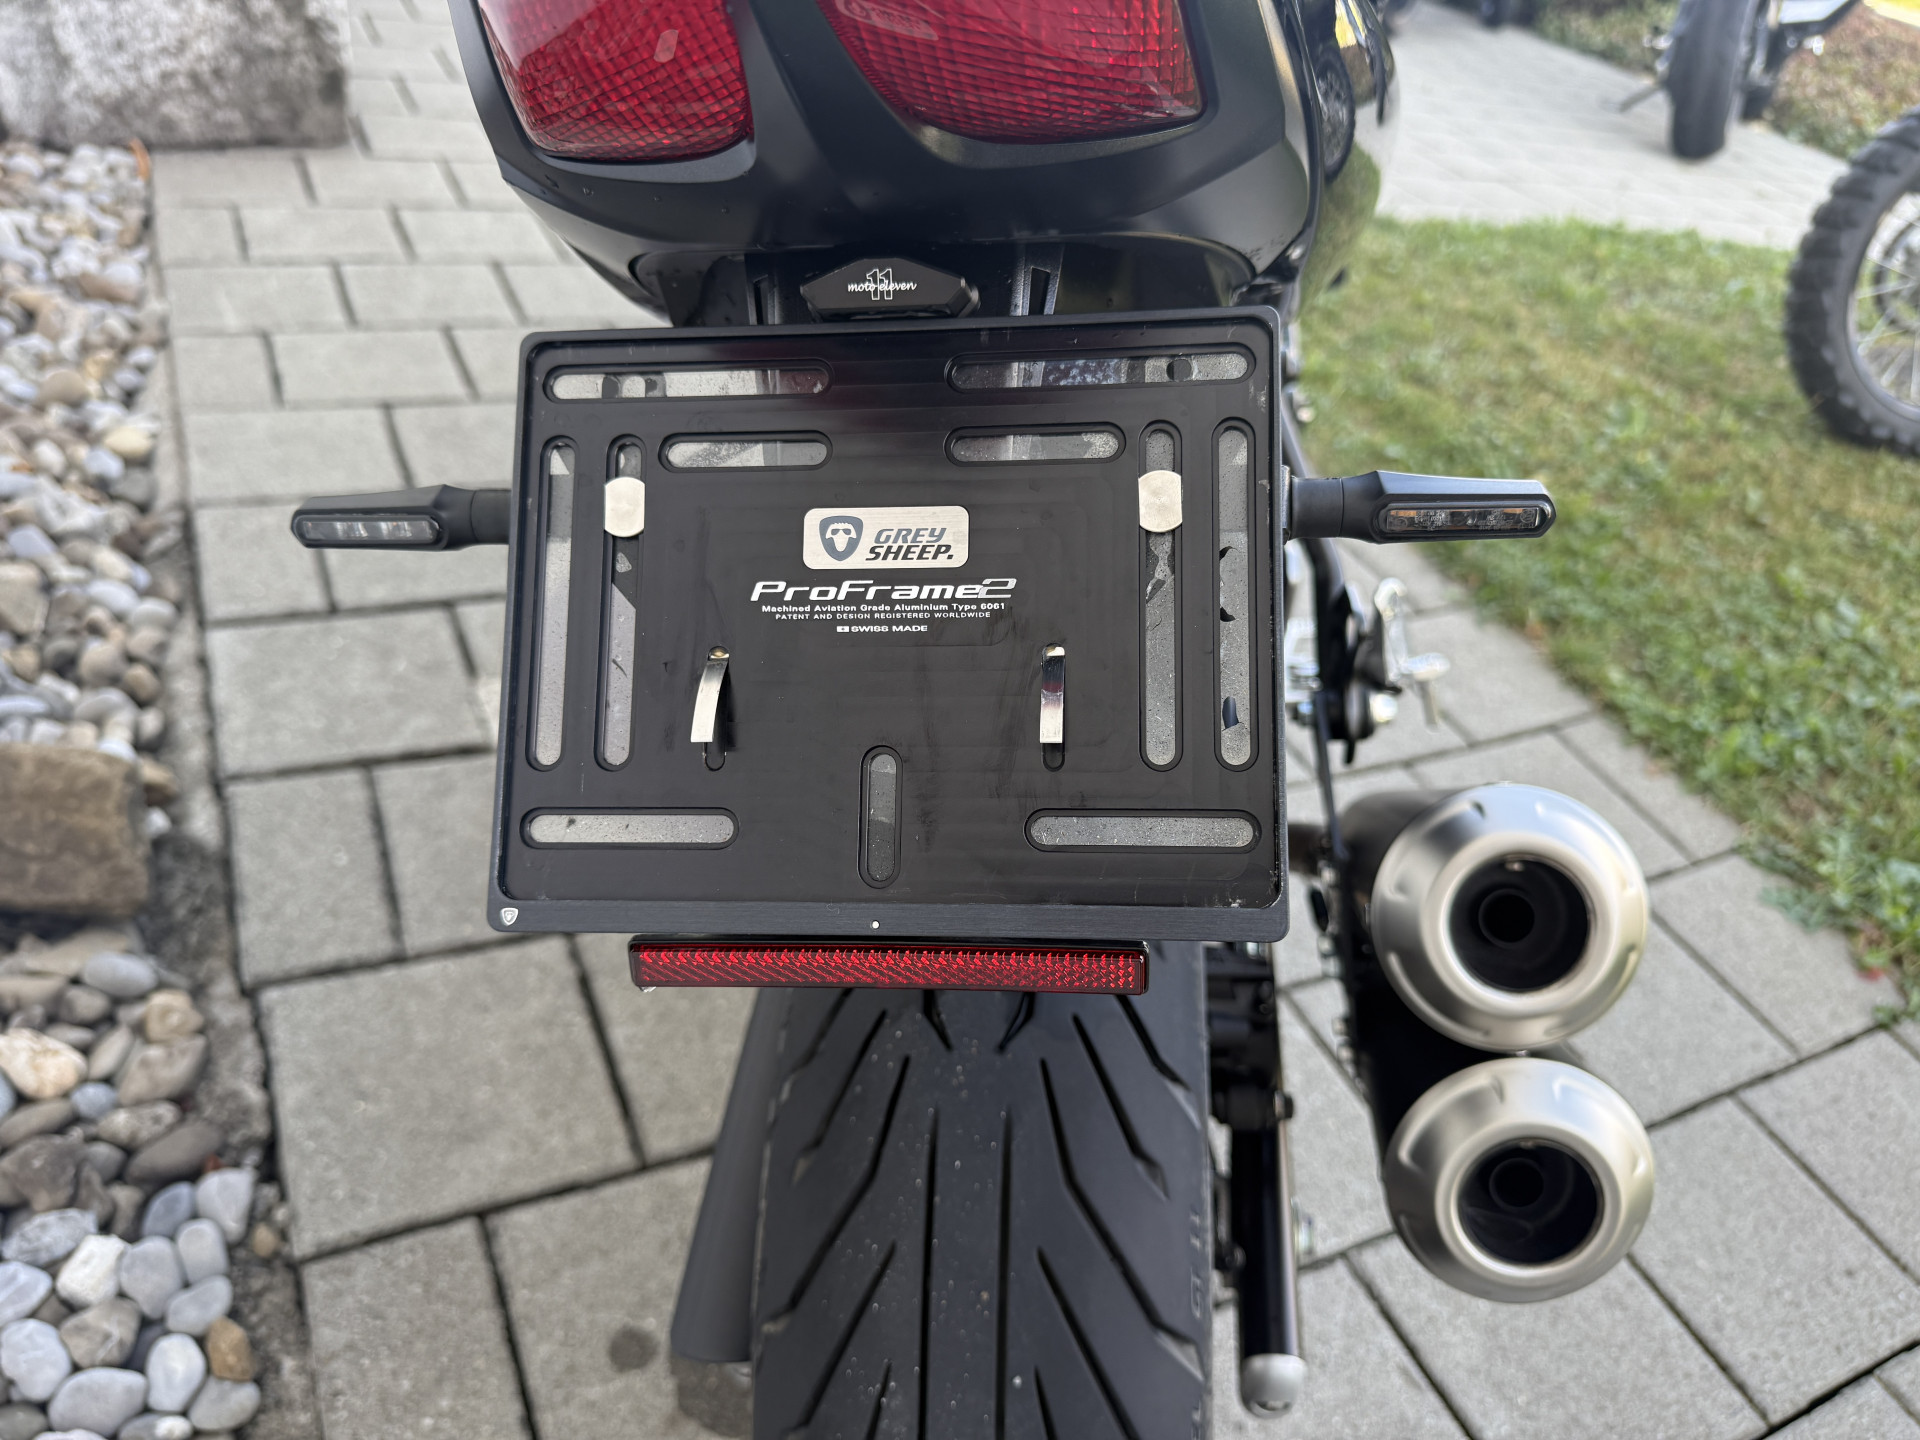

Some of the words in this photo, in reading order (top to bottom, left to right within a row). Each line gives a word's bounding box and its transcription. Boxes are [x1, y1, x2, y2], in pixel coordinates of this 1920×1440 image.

[875, 528, 946, 544] GREY
[761, 604, 811, 613] Machined
[813, 604, 857, 612] Aviation
[859, 603, 891, 612] Grade
[893, 603, 949, 612] Aluminium
[950, 603, 978, 612] Type
[980, 602, 1005, 611] 6061
[813, 612, 833, 620] AND
[836, 612, 871, 620] DESIGN
[873, 612, 931, 620] REGISTERED
[933, 611, 991, 619] WORLDWIDE
[850, 625, 890, 633] SWISS
[891, 624, 928, 633] MADE
